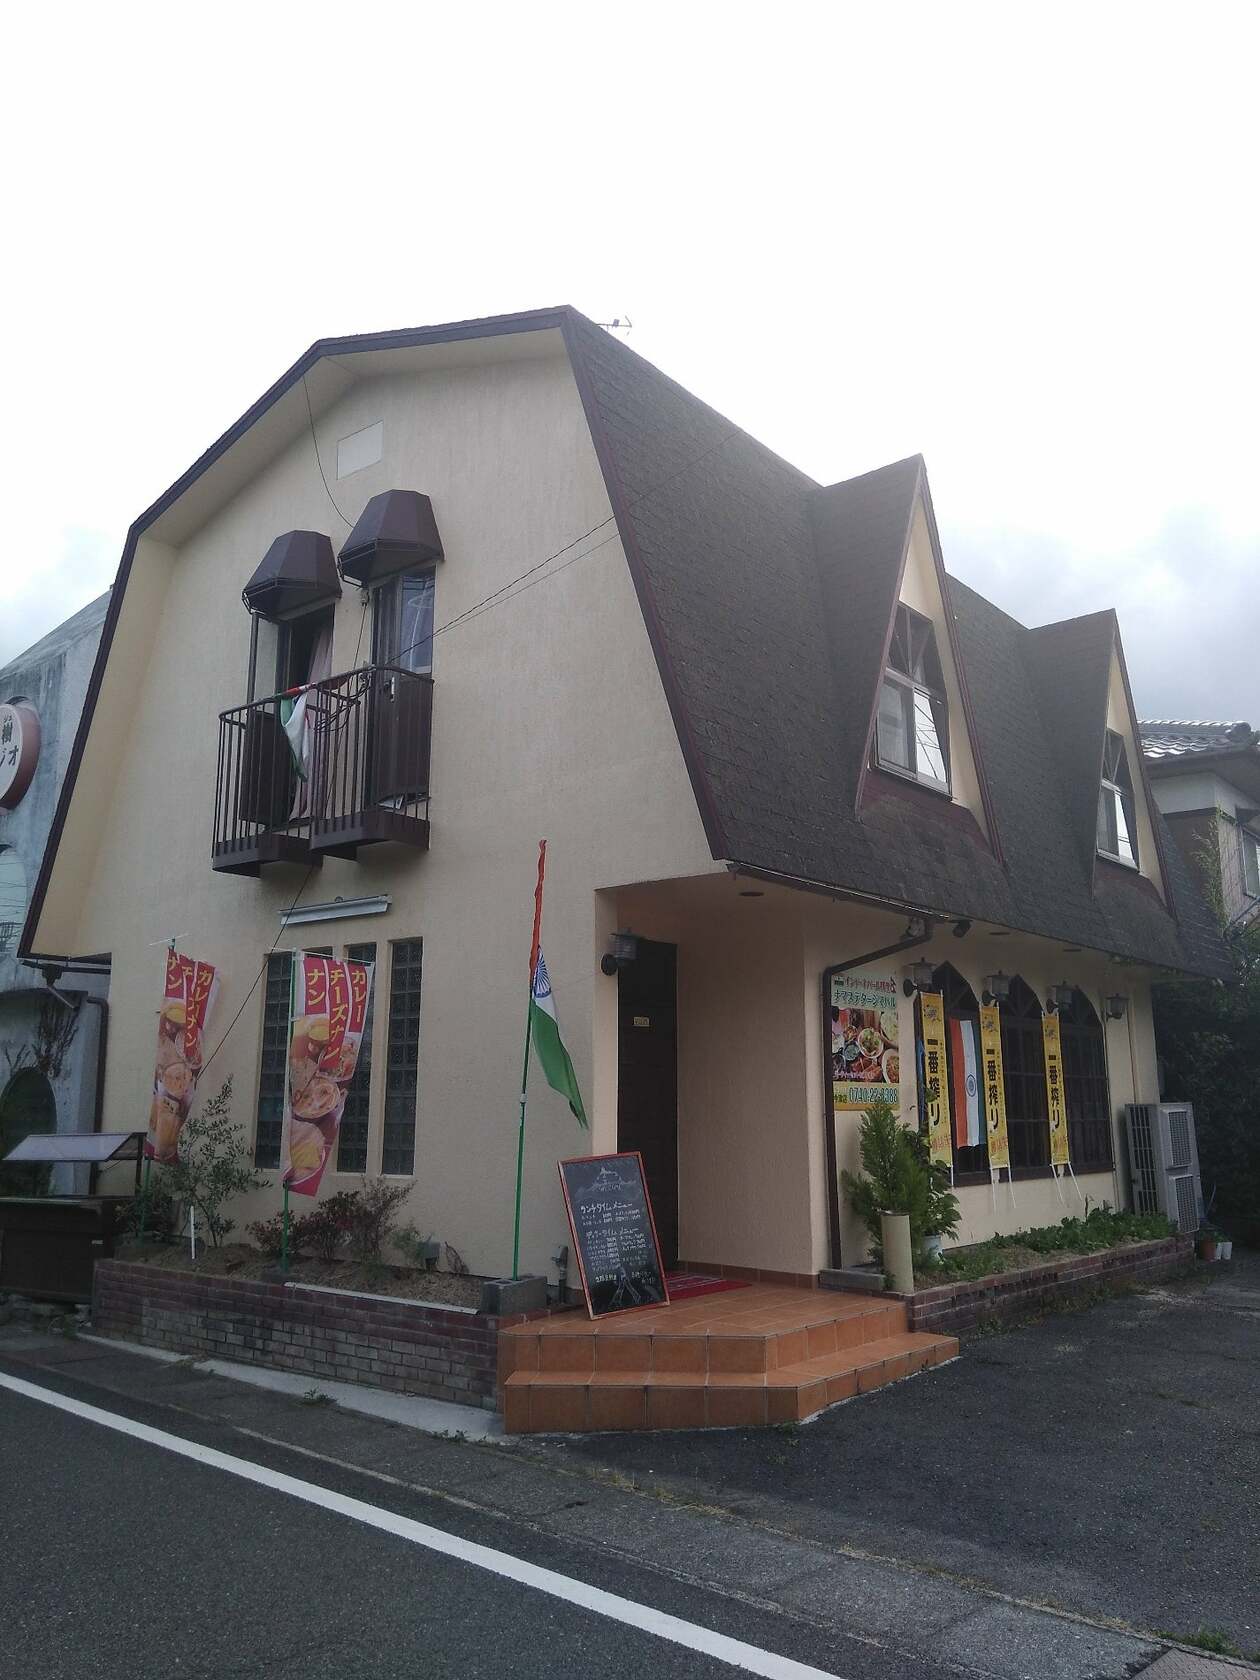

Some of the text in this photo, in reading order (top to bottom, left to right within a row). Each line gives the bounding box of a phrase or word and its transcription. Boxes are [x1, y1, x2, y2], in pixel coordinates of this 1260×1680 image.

[167, 956, 182, 990] ナン
[194, 970, 213, 1020] カレー
[307, 968, 326, 1006] ナン
[351, 970, 367, 1023] カレー
[322, 967, 349, 1061] チーズナン
[927, 1038, 941, 1126] 一番搾り
[986, 1048, 999, 1130] 一番搾り
[1048, 1054, 1060, 1129] 一番搾り
